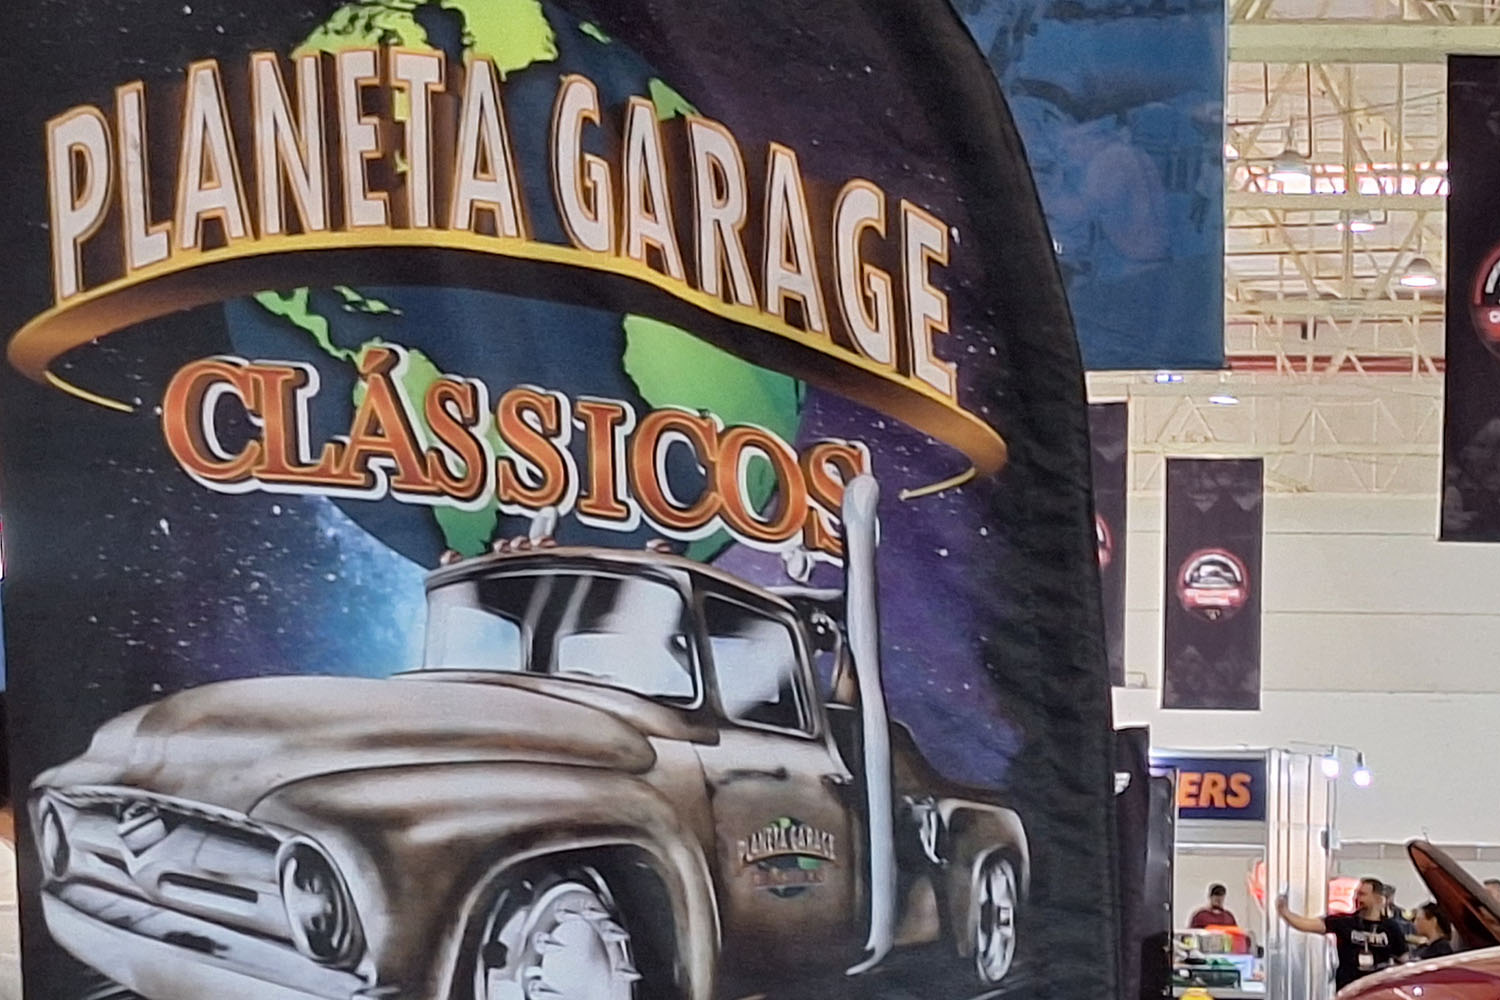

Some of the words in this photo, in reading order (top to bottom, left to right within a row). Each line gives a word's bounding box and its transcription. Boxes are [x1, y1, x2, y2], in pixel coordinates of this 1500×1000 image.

[44, 47, 524, 303] PLANETA
[551, 72, 958, 396] GARAGE
[162, 348, 872, 555] CLÁSSICOS
[1177, 771, 1252, 809] ERS
